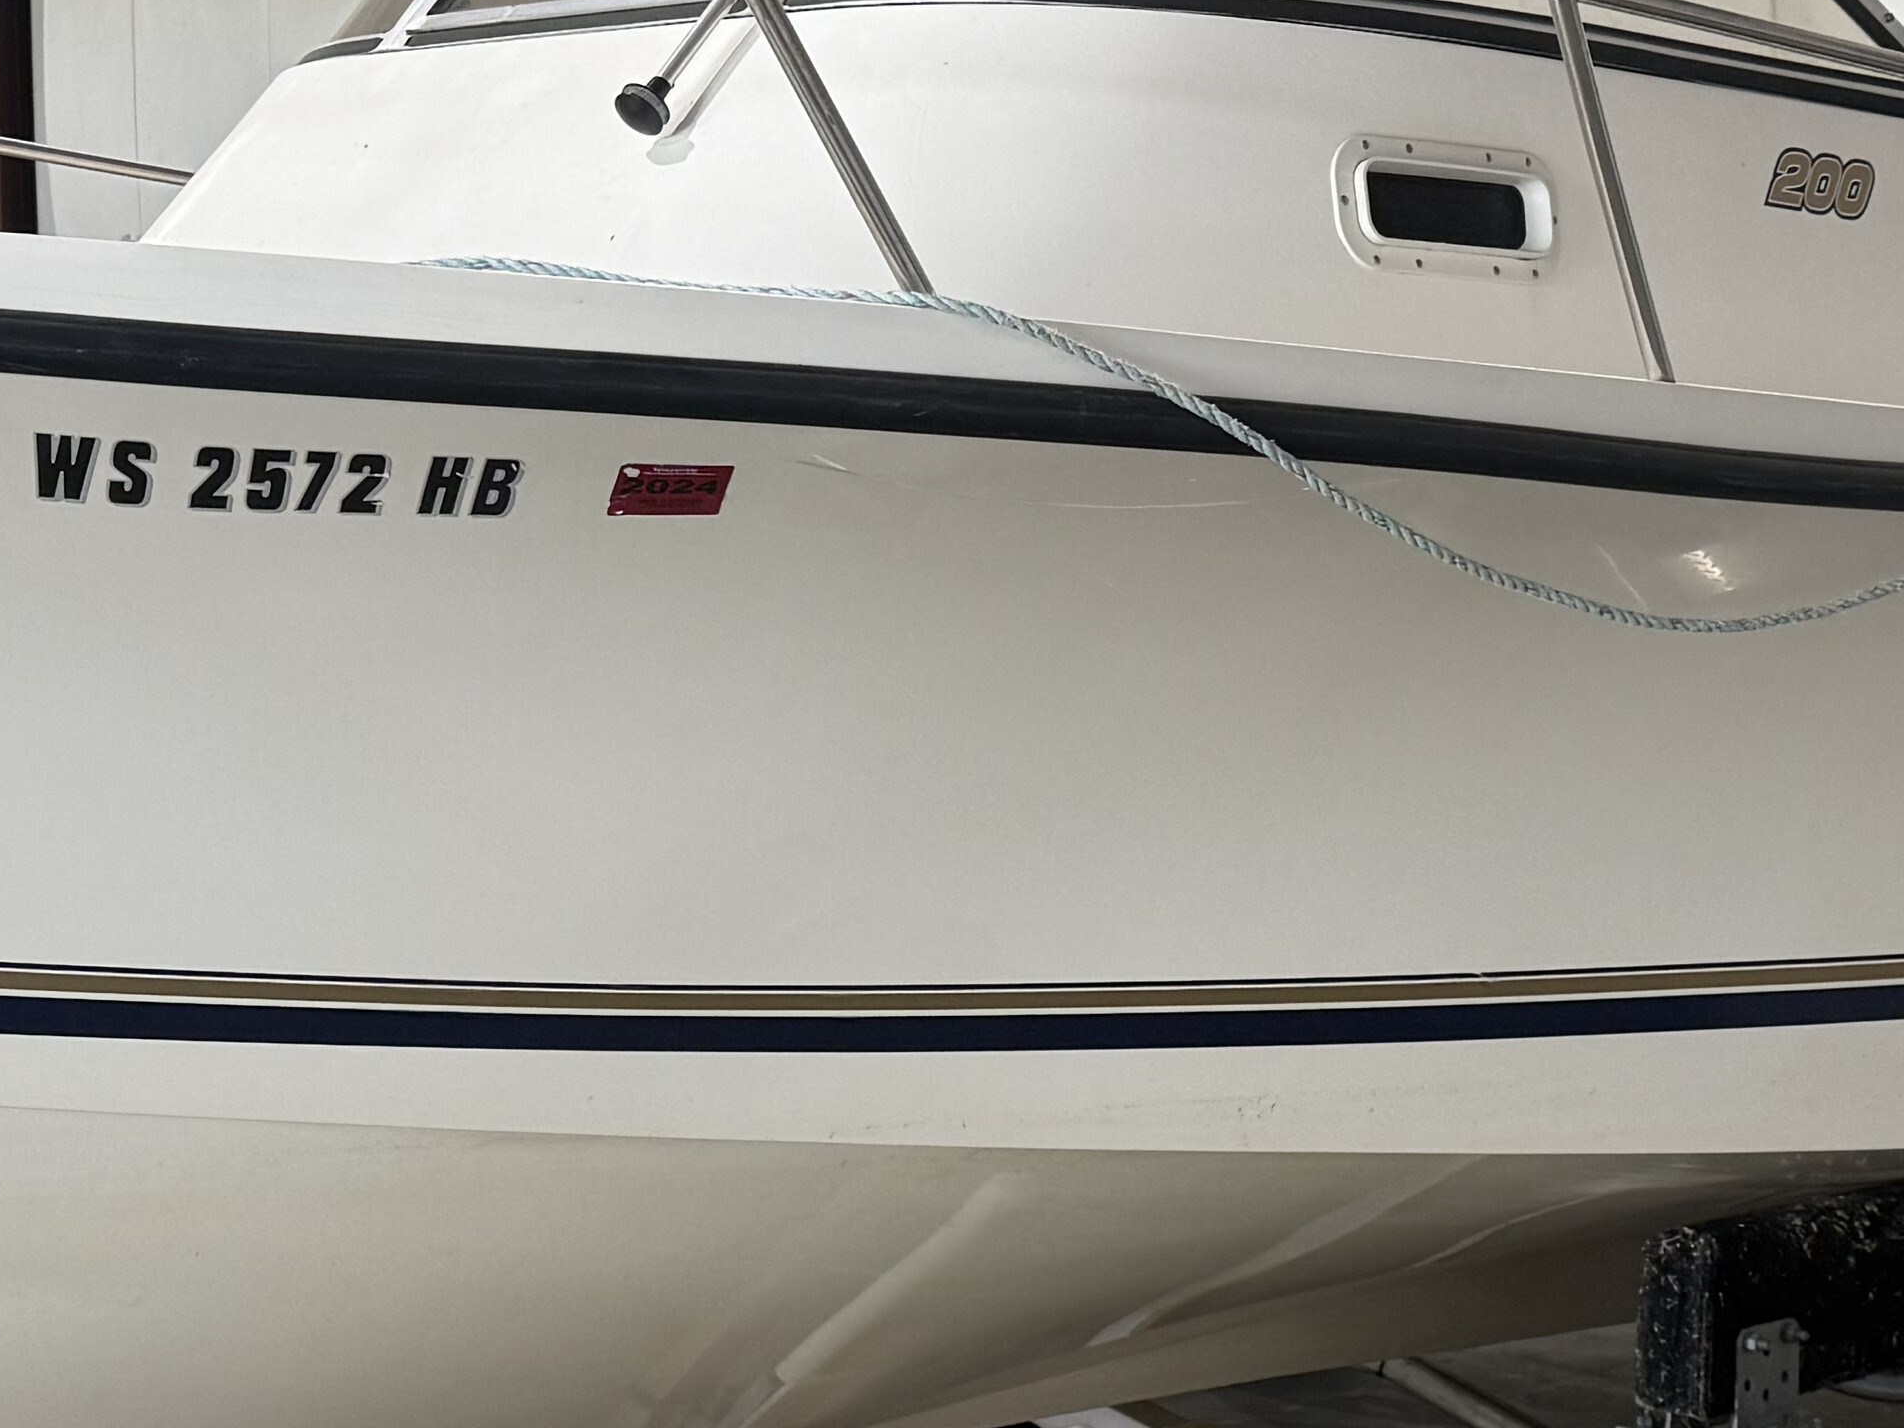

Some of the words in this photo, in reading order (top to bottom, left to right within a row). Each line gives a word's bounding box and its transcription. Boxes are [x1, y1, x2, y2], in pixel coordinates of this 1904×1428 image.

[1764, 147, 1876, 221] 200
[34, 432, 157, 507] WS
[187, 446, 393, 516] 2572
[417, 456, 526, 518] HB
[620, 478, 719, 495] 2024
